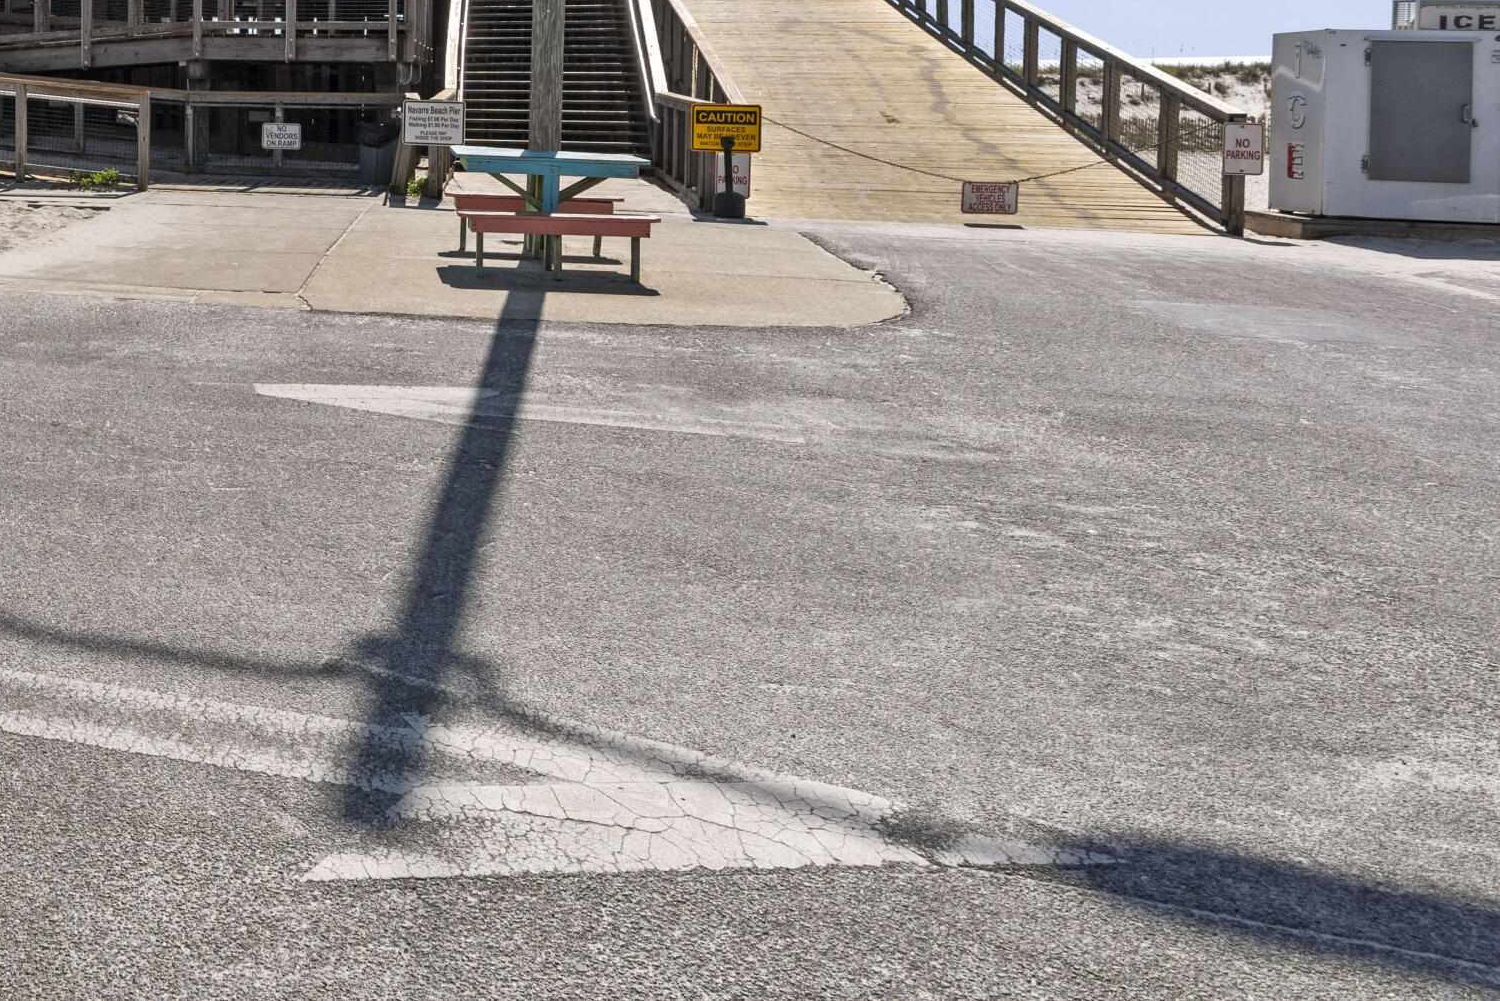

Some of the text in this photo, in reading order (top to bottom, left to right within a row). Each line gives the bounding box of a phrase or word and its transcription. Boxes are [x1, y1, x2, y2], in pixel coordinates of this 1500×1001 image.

[1439, 14, 1496, 30] ICE
[407, 105, 460, 115] Navarre Beach Pier
[699, 112, 755, 123] CAUTION
[276, 124, 287, 132] NO
[266, 132, 297, 140] VENDORS
[278, 139, 297, 147] RAMP
[1235, 138, 1250, 148] NO
[1226, 149, 1260, 160] PARKING
[718, 175, 747, 185] PAKING
[971, 184, 1010, 194] EMERGENCY
[976, 194, 1006, 203] VEHICLES
[969, 202, 1011, 212] ACCESS ONLY
